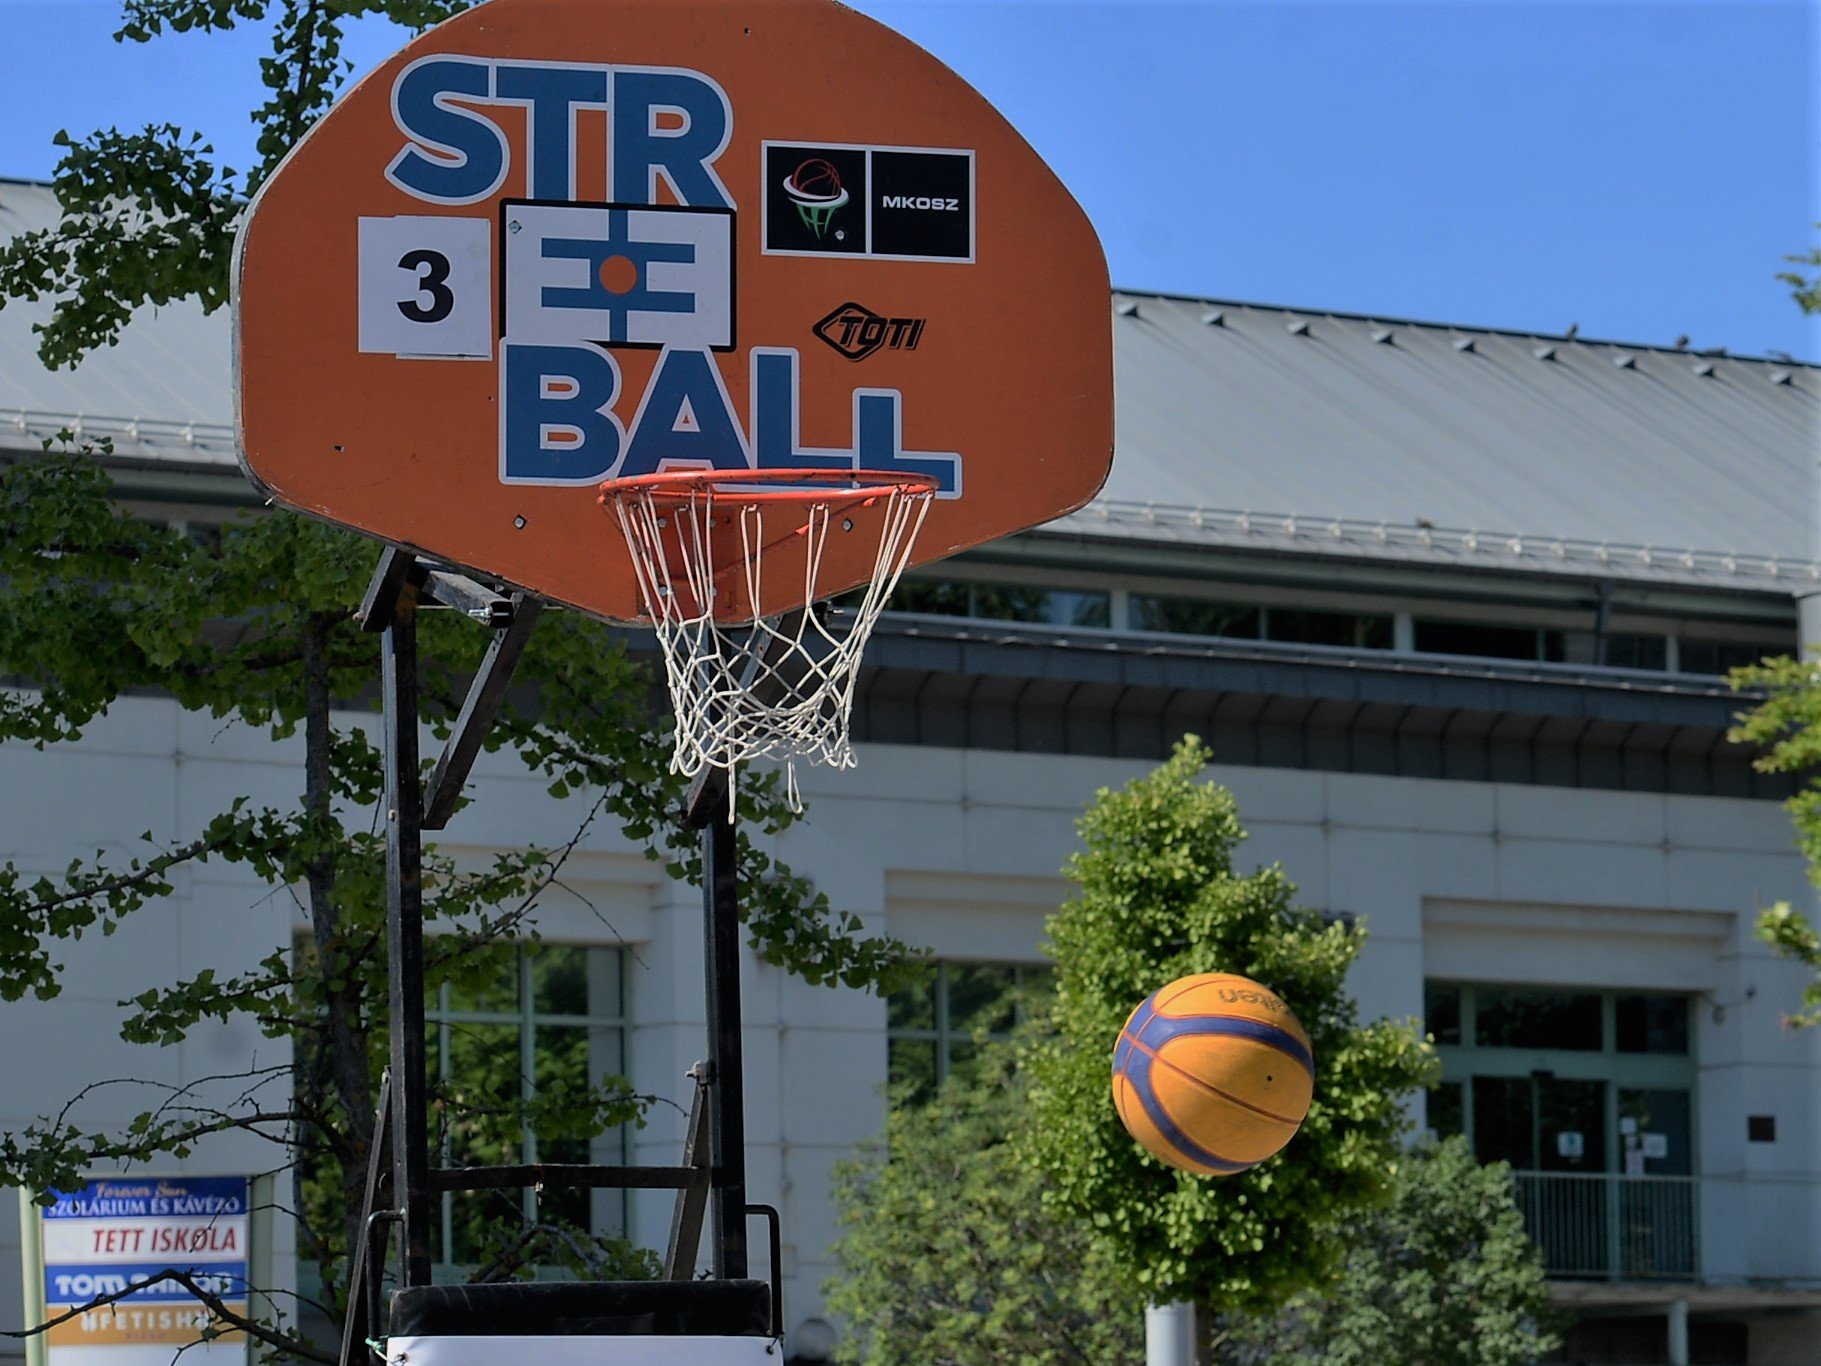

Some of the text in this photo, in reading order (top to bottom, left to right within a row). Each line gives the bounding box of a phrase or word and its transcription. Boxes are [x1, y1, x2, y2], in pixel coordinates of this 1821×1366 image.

[386, 54, 736, 207] STR
[882, 196, 959, 211] MKOSZ
[397, 250, 454, 322] 3
[839, 316, 926, 350] TOTI
[499, 338, 962, 498] BALL
[94, 1227, 236, 1253] TETT ISKOLA
[55, 1273, 127, 1297] TOM
